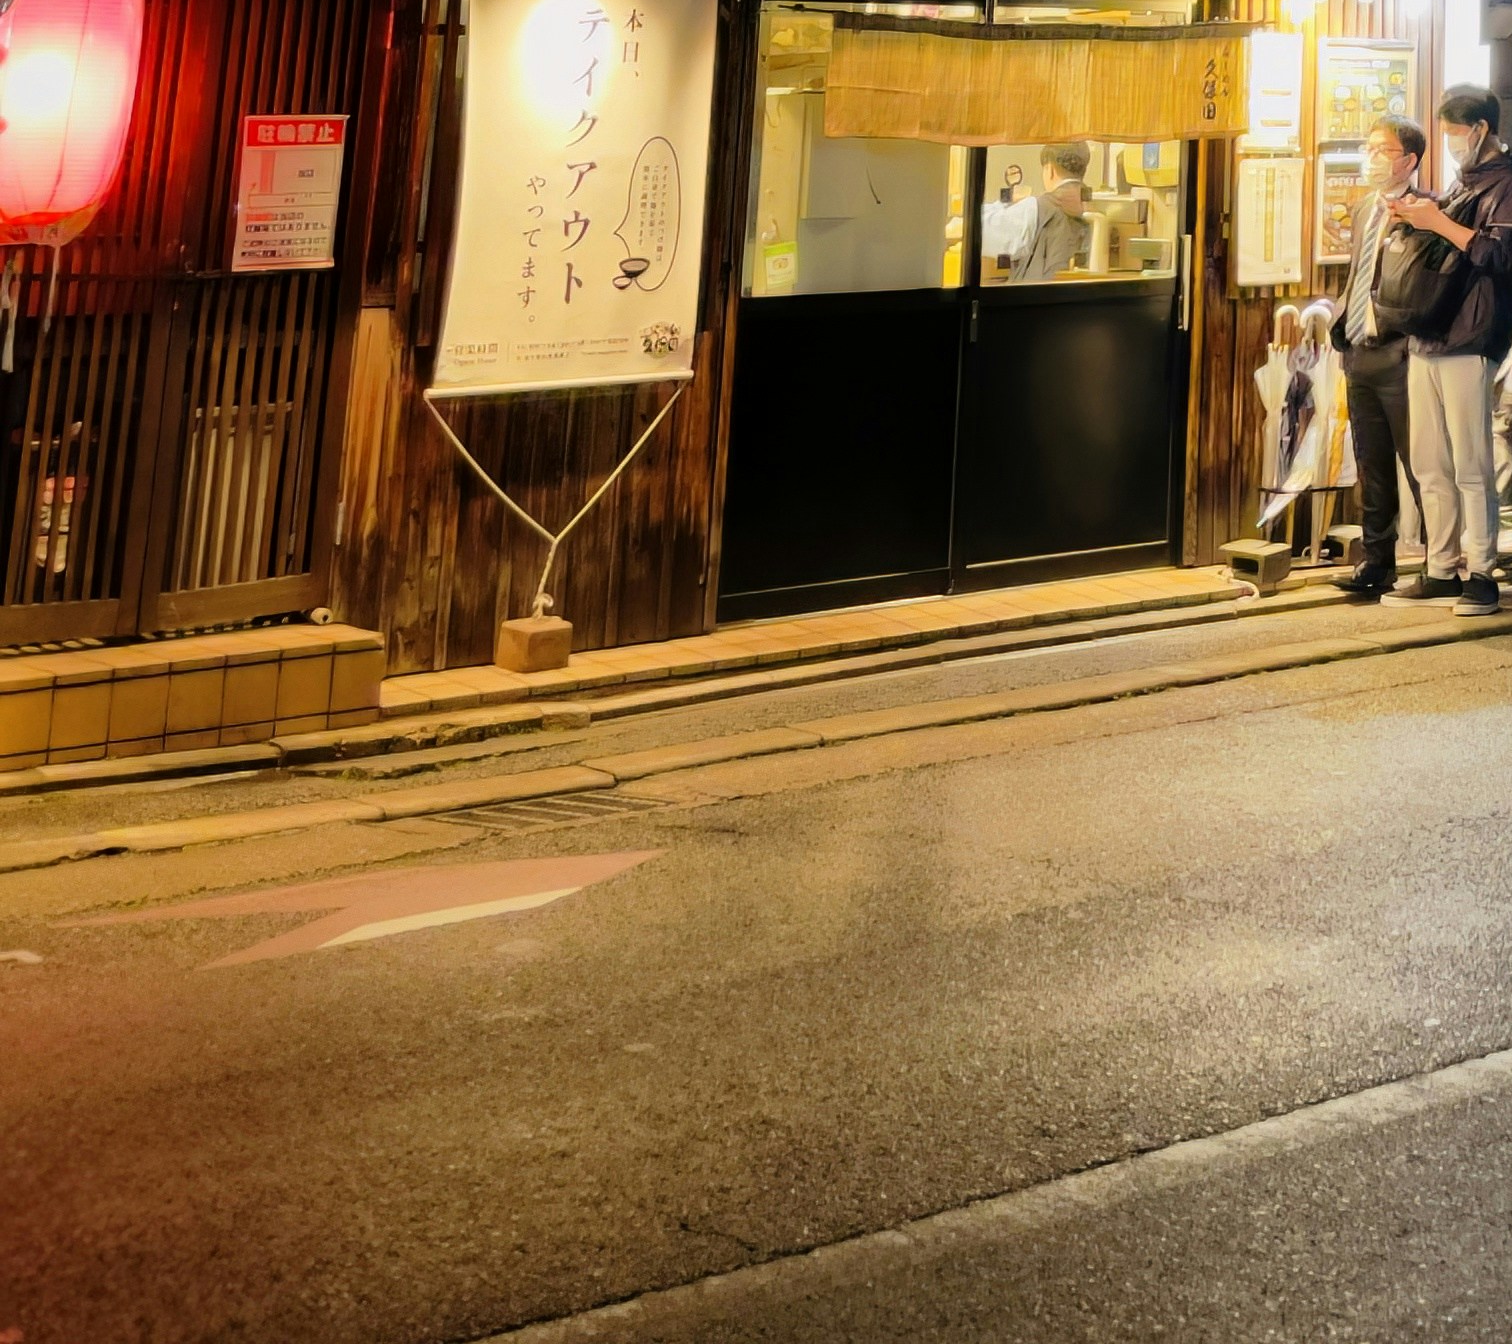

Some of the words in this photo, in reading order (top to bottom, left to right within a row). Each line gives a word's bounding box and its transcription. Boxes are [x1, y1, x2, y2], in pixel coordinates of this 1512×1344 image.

[517, 175, 547, 323] やってます。
[560, 8, 611, 305] テイクアウト
